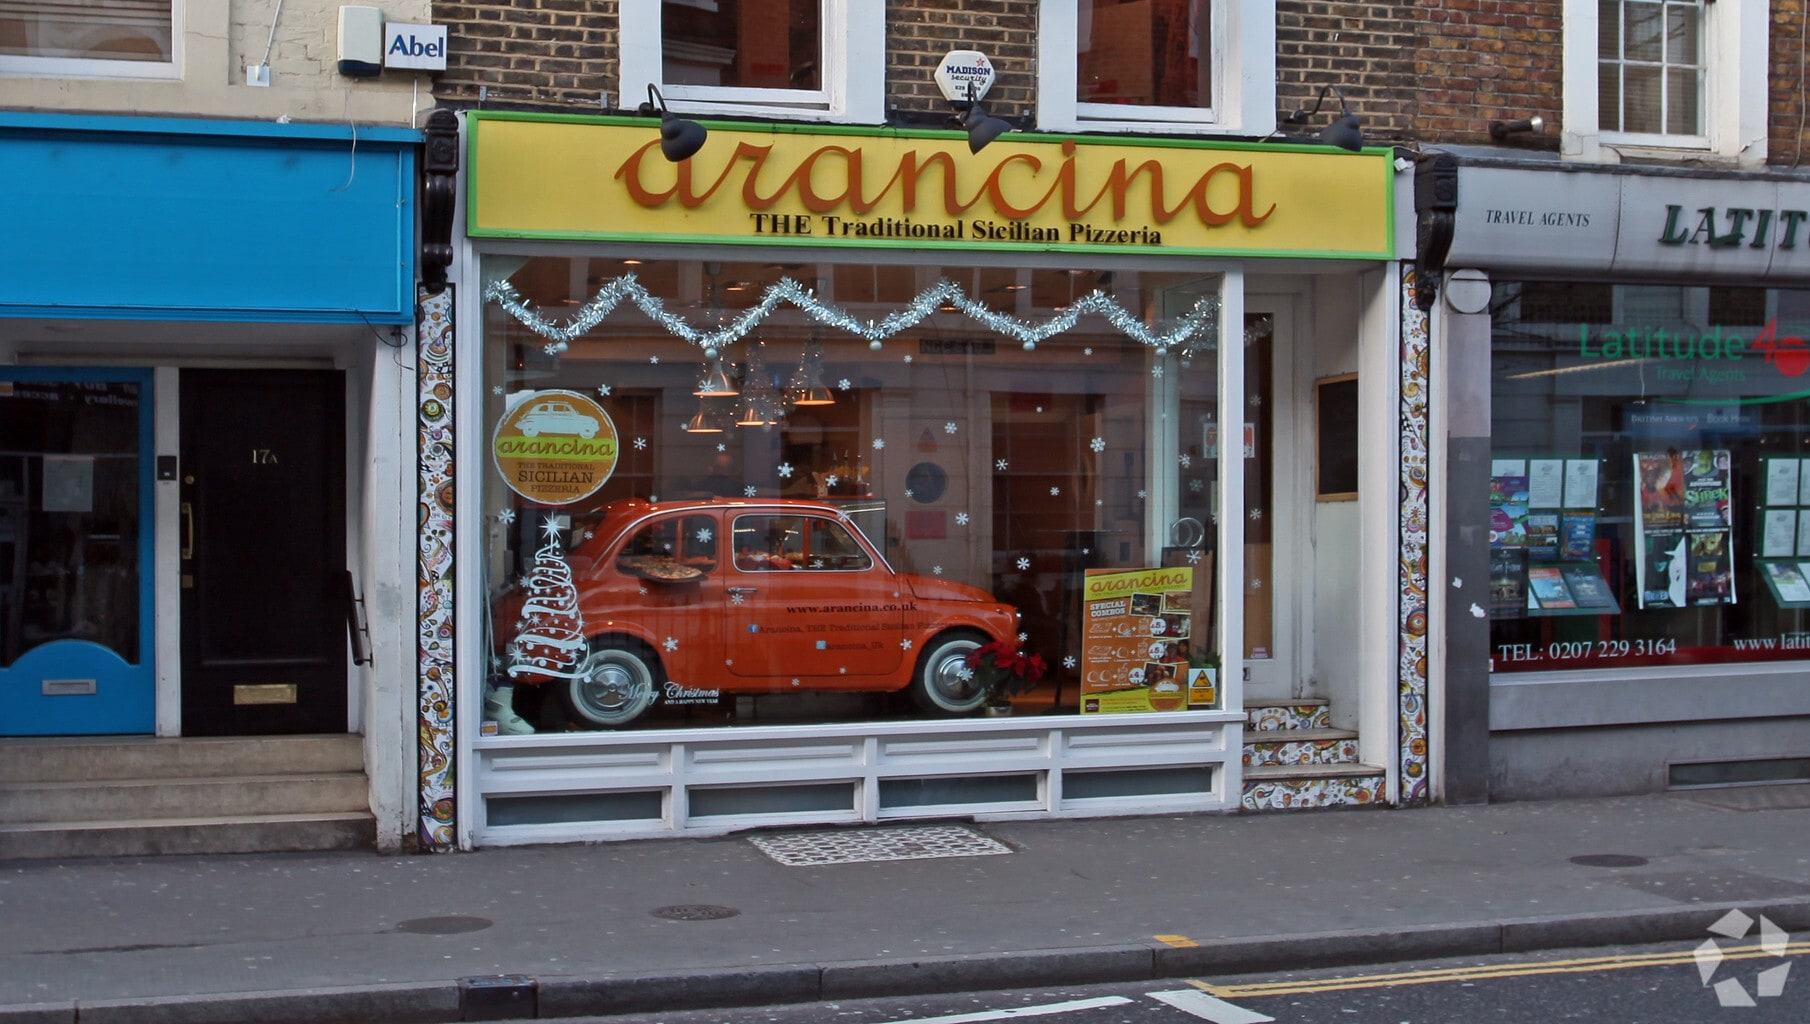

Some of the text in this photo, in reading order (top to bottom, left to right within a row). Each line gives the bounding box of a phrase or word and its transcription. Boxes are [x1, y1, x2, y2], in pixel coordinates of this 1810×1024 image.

[388, 34, 444, 58] Abel
[946, 65, 991, 76] MADISON
[950, 75, 987, 86] security
[614, 138, 1277, 229] arancina
[1485, 209, 1591, 228] TRAVEL AGENTS
[1657, 204, 1810, 250] LATIT
[750, 213, 1162, 245] THE Traditional Sicilian Pizzeria
[1579, 322, 1746, 361] Latitude
[1655, 364, 1746, 385] Travel Agents
[497, 438, 614, 457] arancina
[517, 461, 595, 471] THE TRADITIONAL
[518, 470, 594, 484] SICILIAN
[530, 484, 580, 494] PIZZERIA
[1090, 571, 1188, 593] arancina
[786, 601, 918, 614] www.arancina.co.uk
[1090, 600, 1126, 610] SPECIAL
[1091, 607, 1126, 618] COMBOS
[1498, 637, 1677, 662] TEL: 0207 229 3164
[618, 681, 720, 706] Merry Christmas
